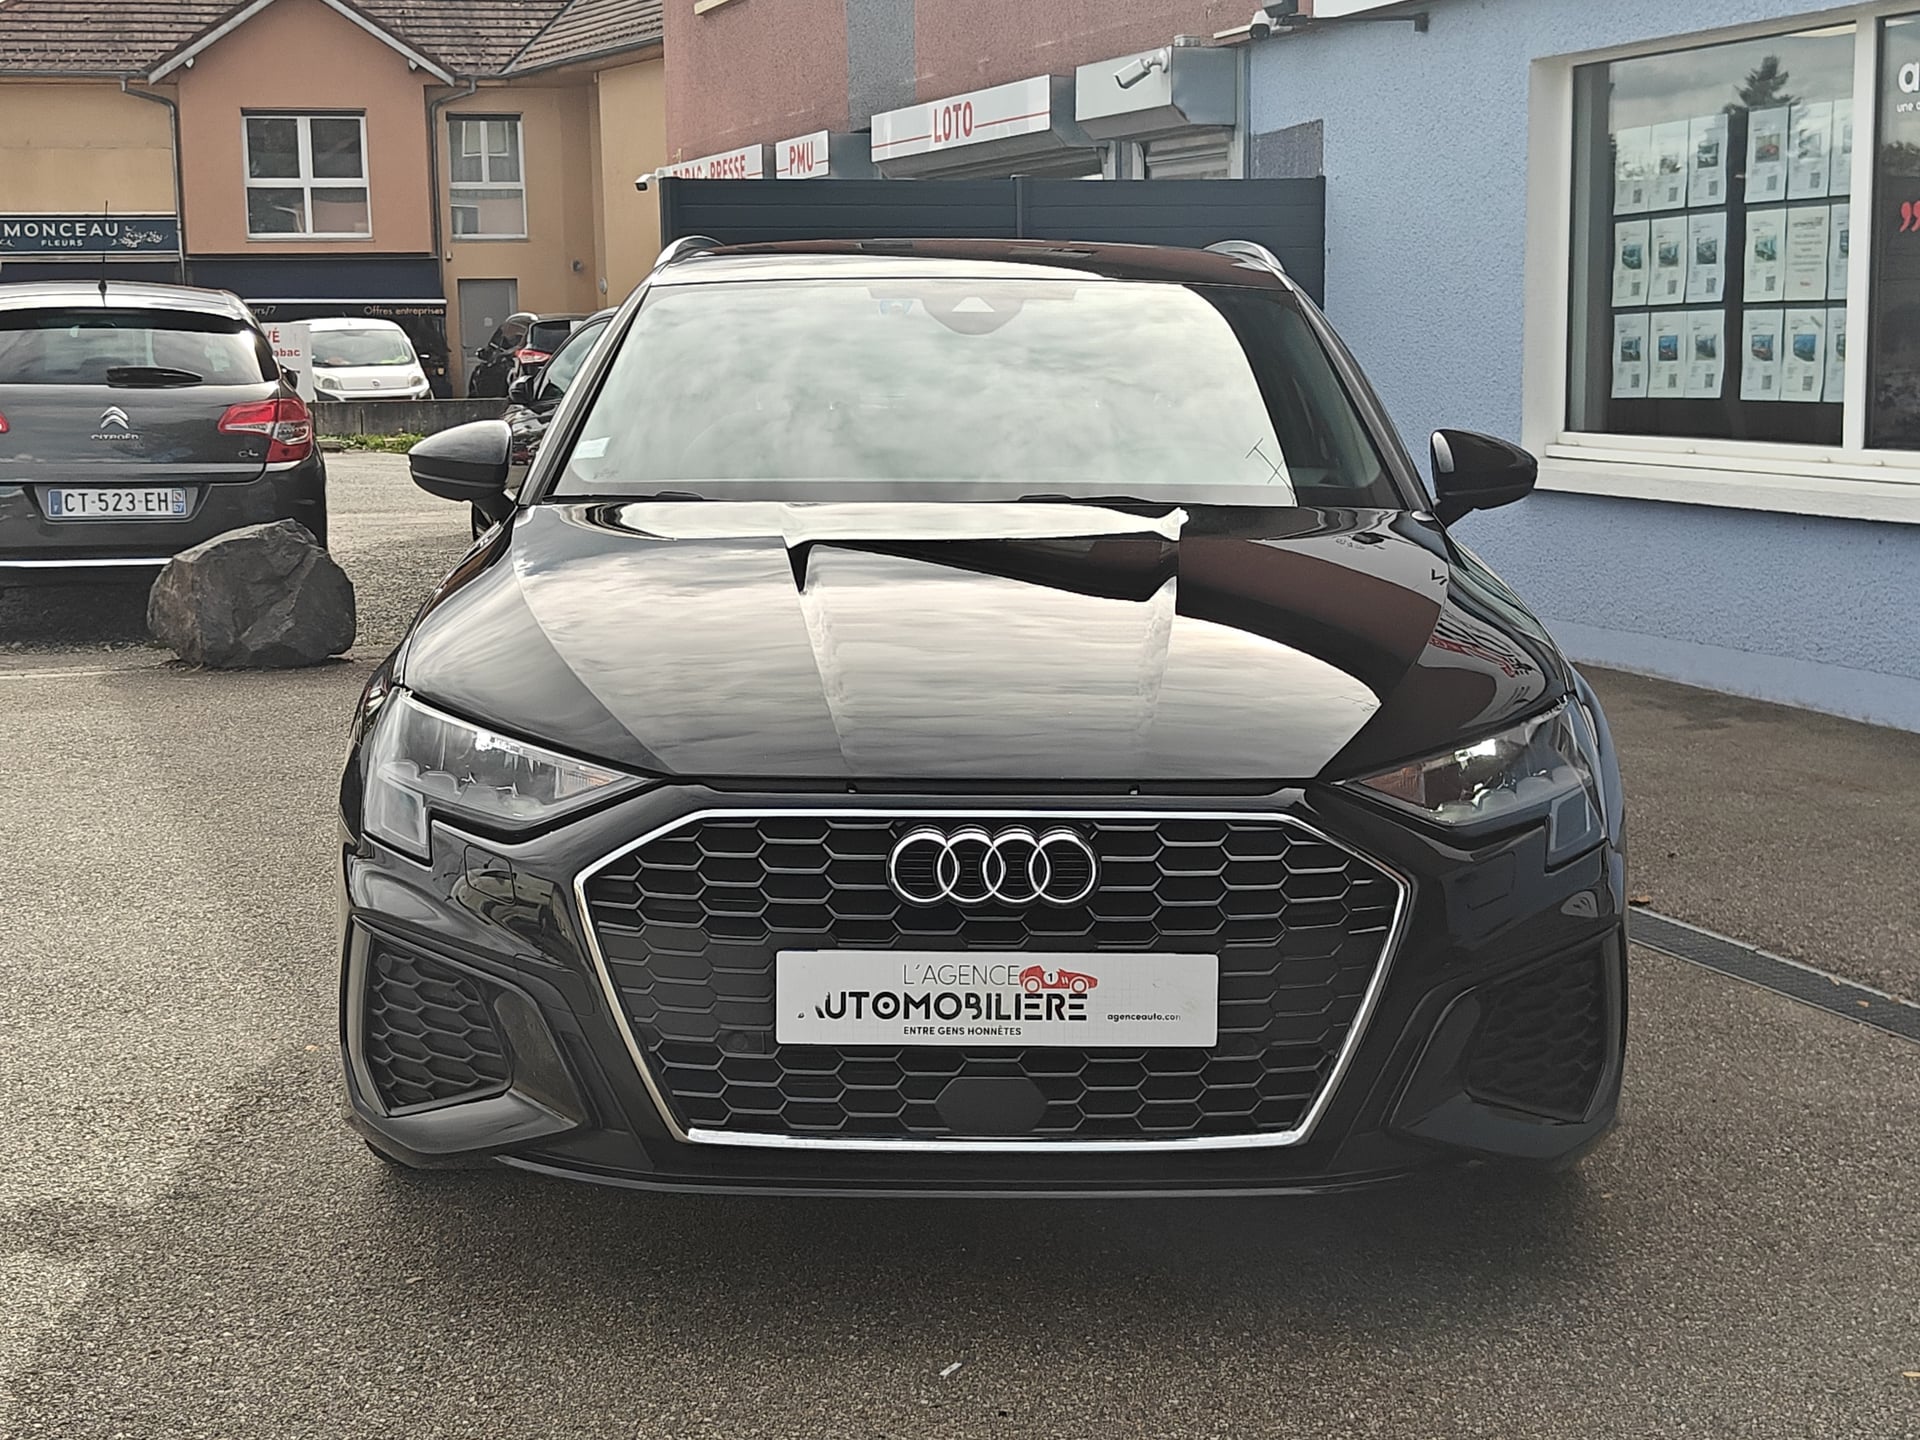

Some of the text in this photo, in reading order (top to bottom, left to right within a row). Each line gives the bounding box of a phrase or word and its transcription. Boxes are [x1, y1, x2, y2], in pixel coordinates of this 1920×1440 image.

[933, 101, 973, 143] LOTO
[789, 141, 814, 176] PMU
[4, 222, 119, 237] MONCEAU
[41, 239, 83, 247] FLEURS
[363, 305, 444, 318] Offres entreprises
[64, 492, 169, 513] CT-523-EH
[903, 964, 1020, 985] L'AGENCE
[903, 1024, 1022, 1036] ENTRE GENS HONNÊTES
